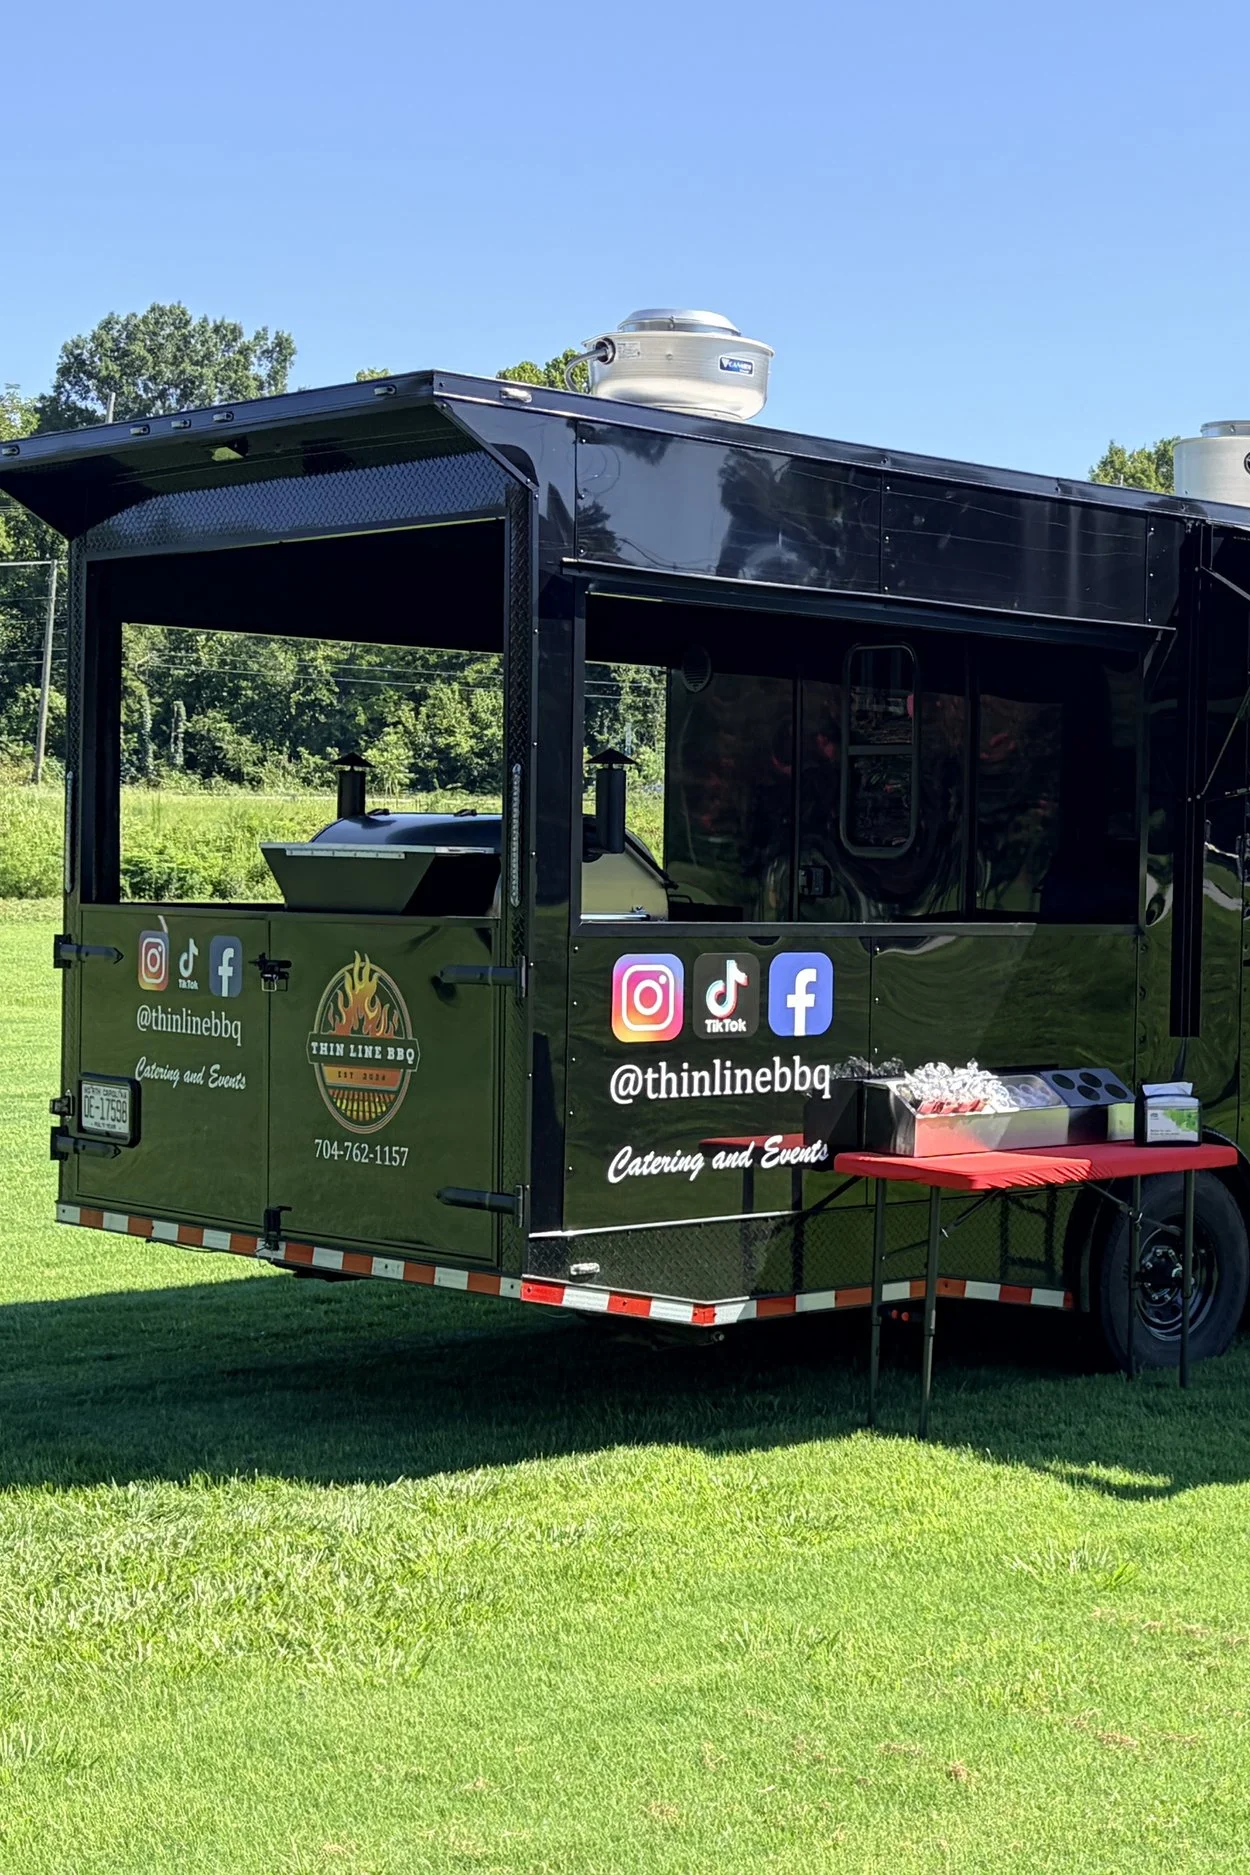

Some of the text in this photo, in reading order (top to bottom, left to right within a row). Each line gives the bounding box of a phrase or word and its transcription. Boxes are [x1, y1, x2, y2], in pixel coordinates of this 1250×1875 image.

[178, 979, 199, 990] TikTok
[137, 1004, 242, 1047] @thinlinebbq
[704, 1018, 747, 1033] TikTok
[311, 1042, 415, 1064] THIN LINE BBQ
[135, 1056, 247, 1090] Catering and Events
[610, 1055, 832, 1105] @thinlinebbq
[314, 1139, 409, 1167] 704-762-1157
[607, 1135, 830, 1184] Catering and Events
